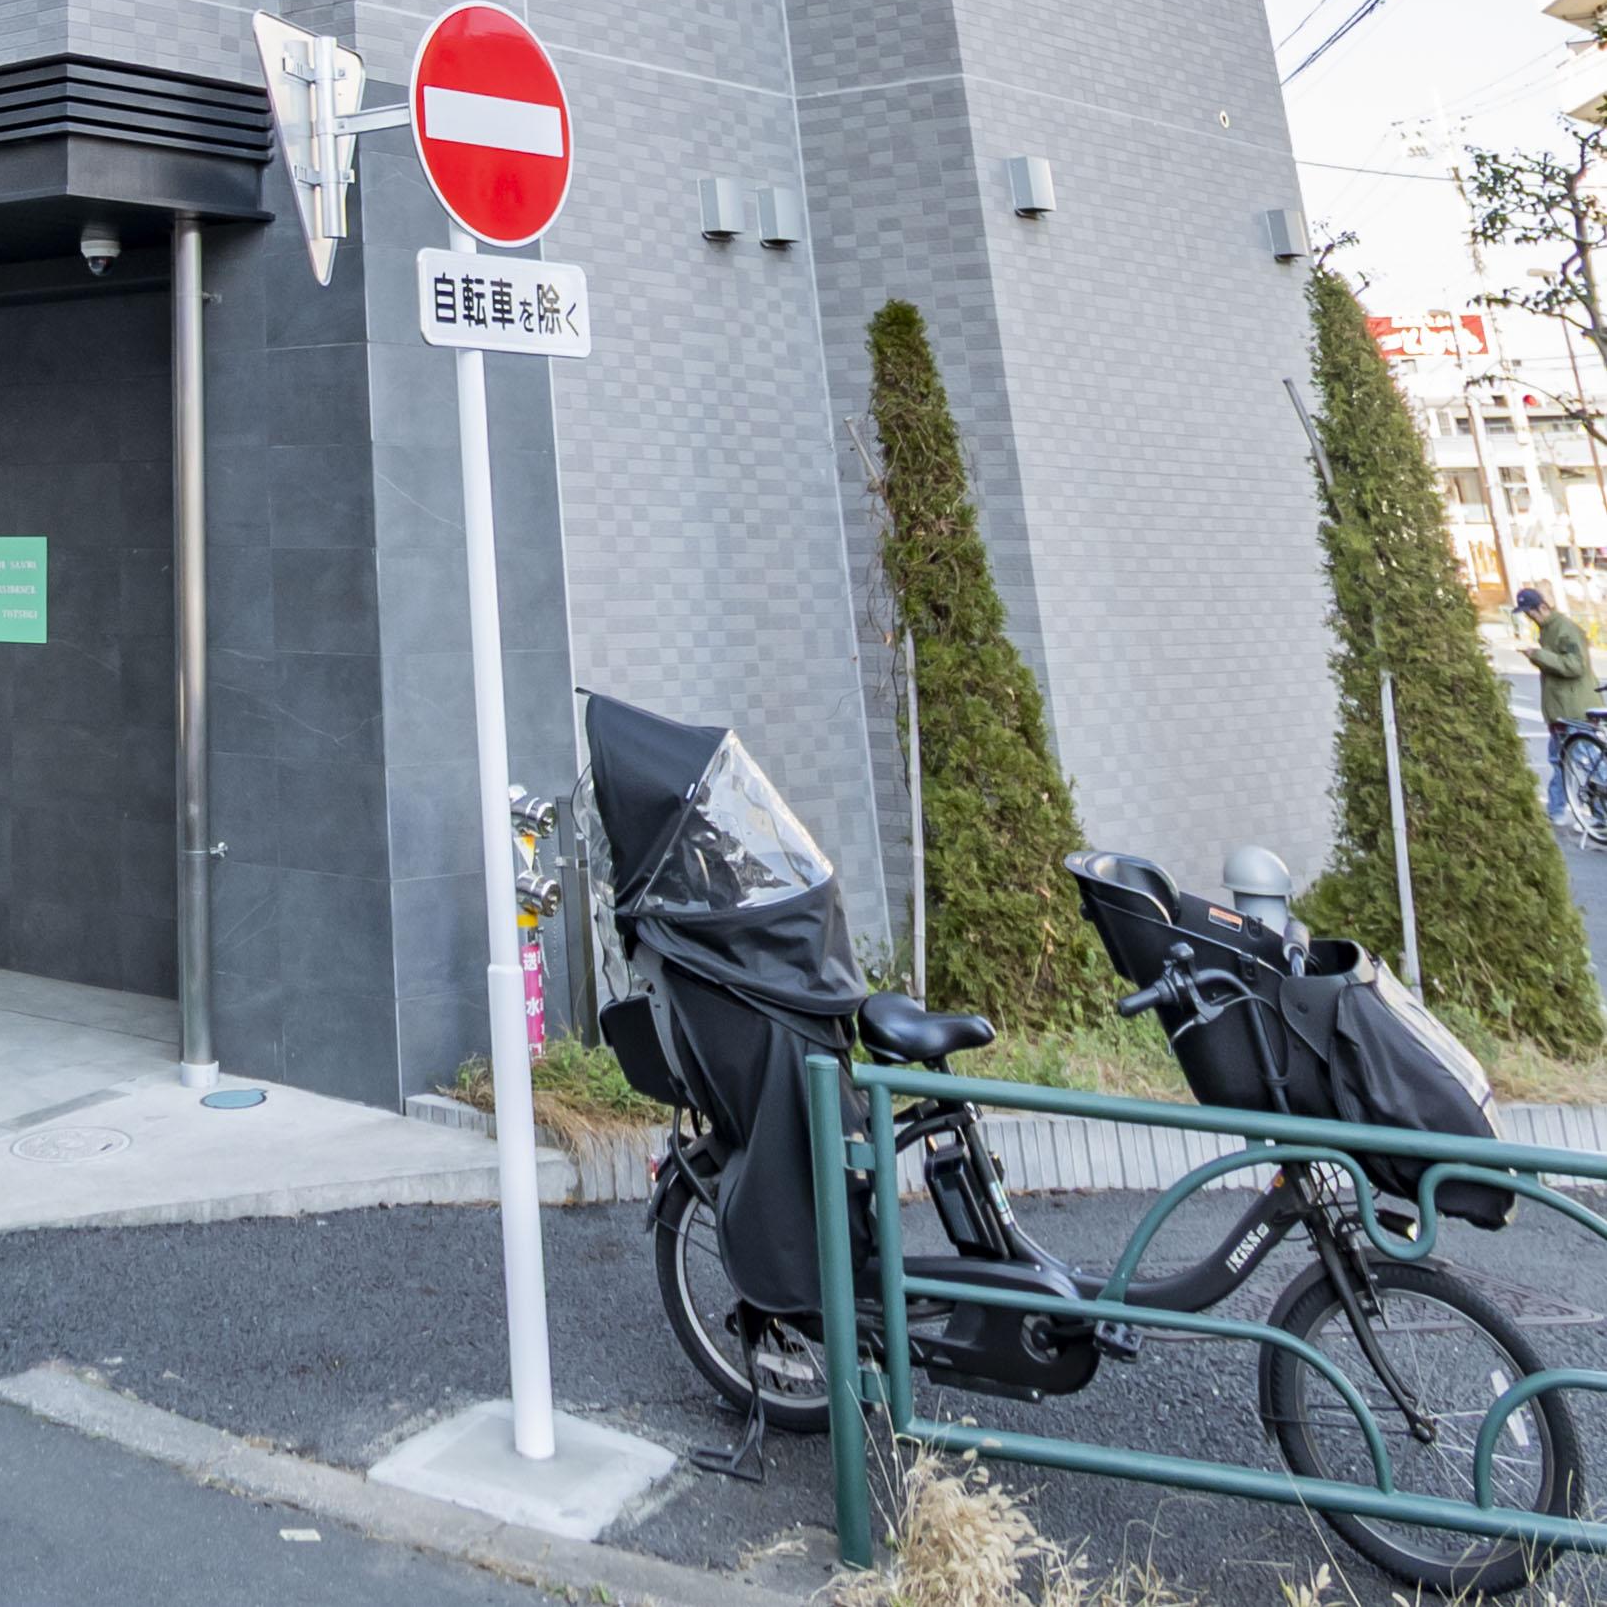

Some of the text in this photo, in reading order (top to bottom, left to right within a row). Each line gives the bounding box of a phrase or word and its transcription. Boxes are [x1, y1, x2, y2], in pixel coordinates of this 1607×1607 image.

[433, 271, 580, 337] 自転車を除く
